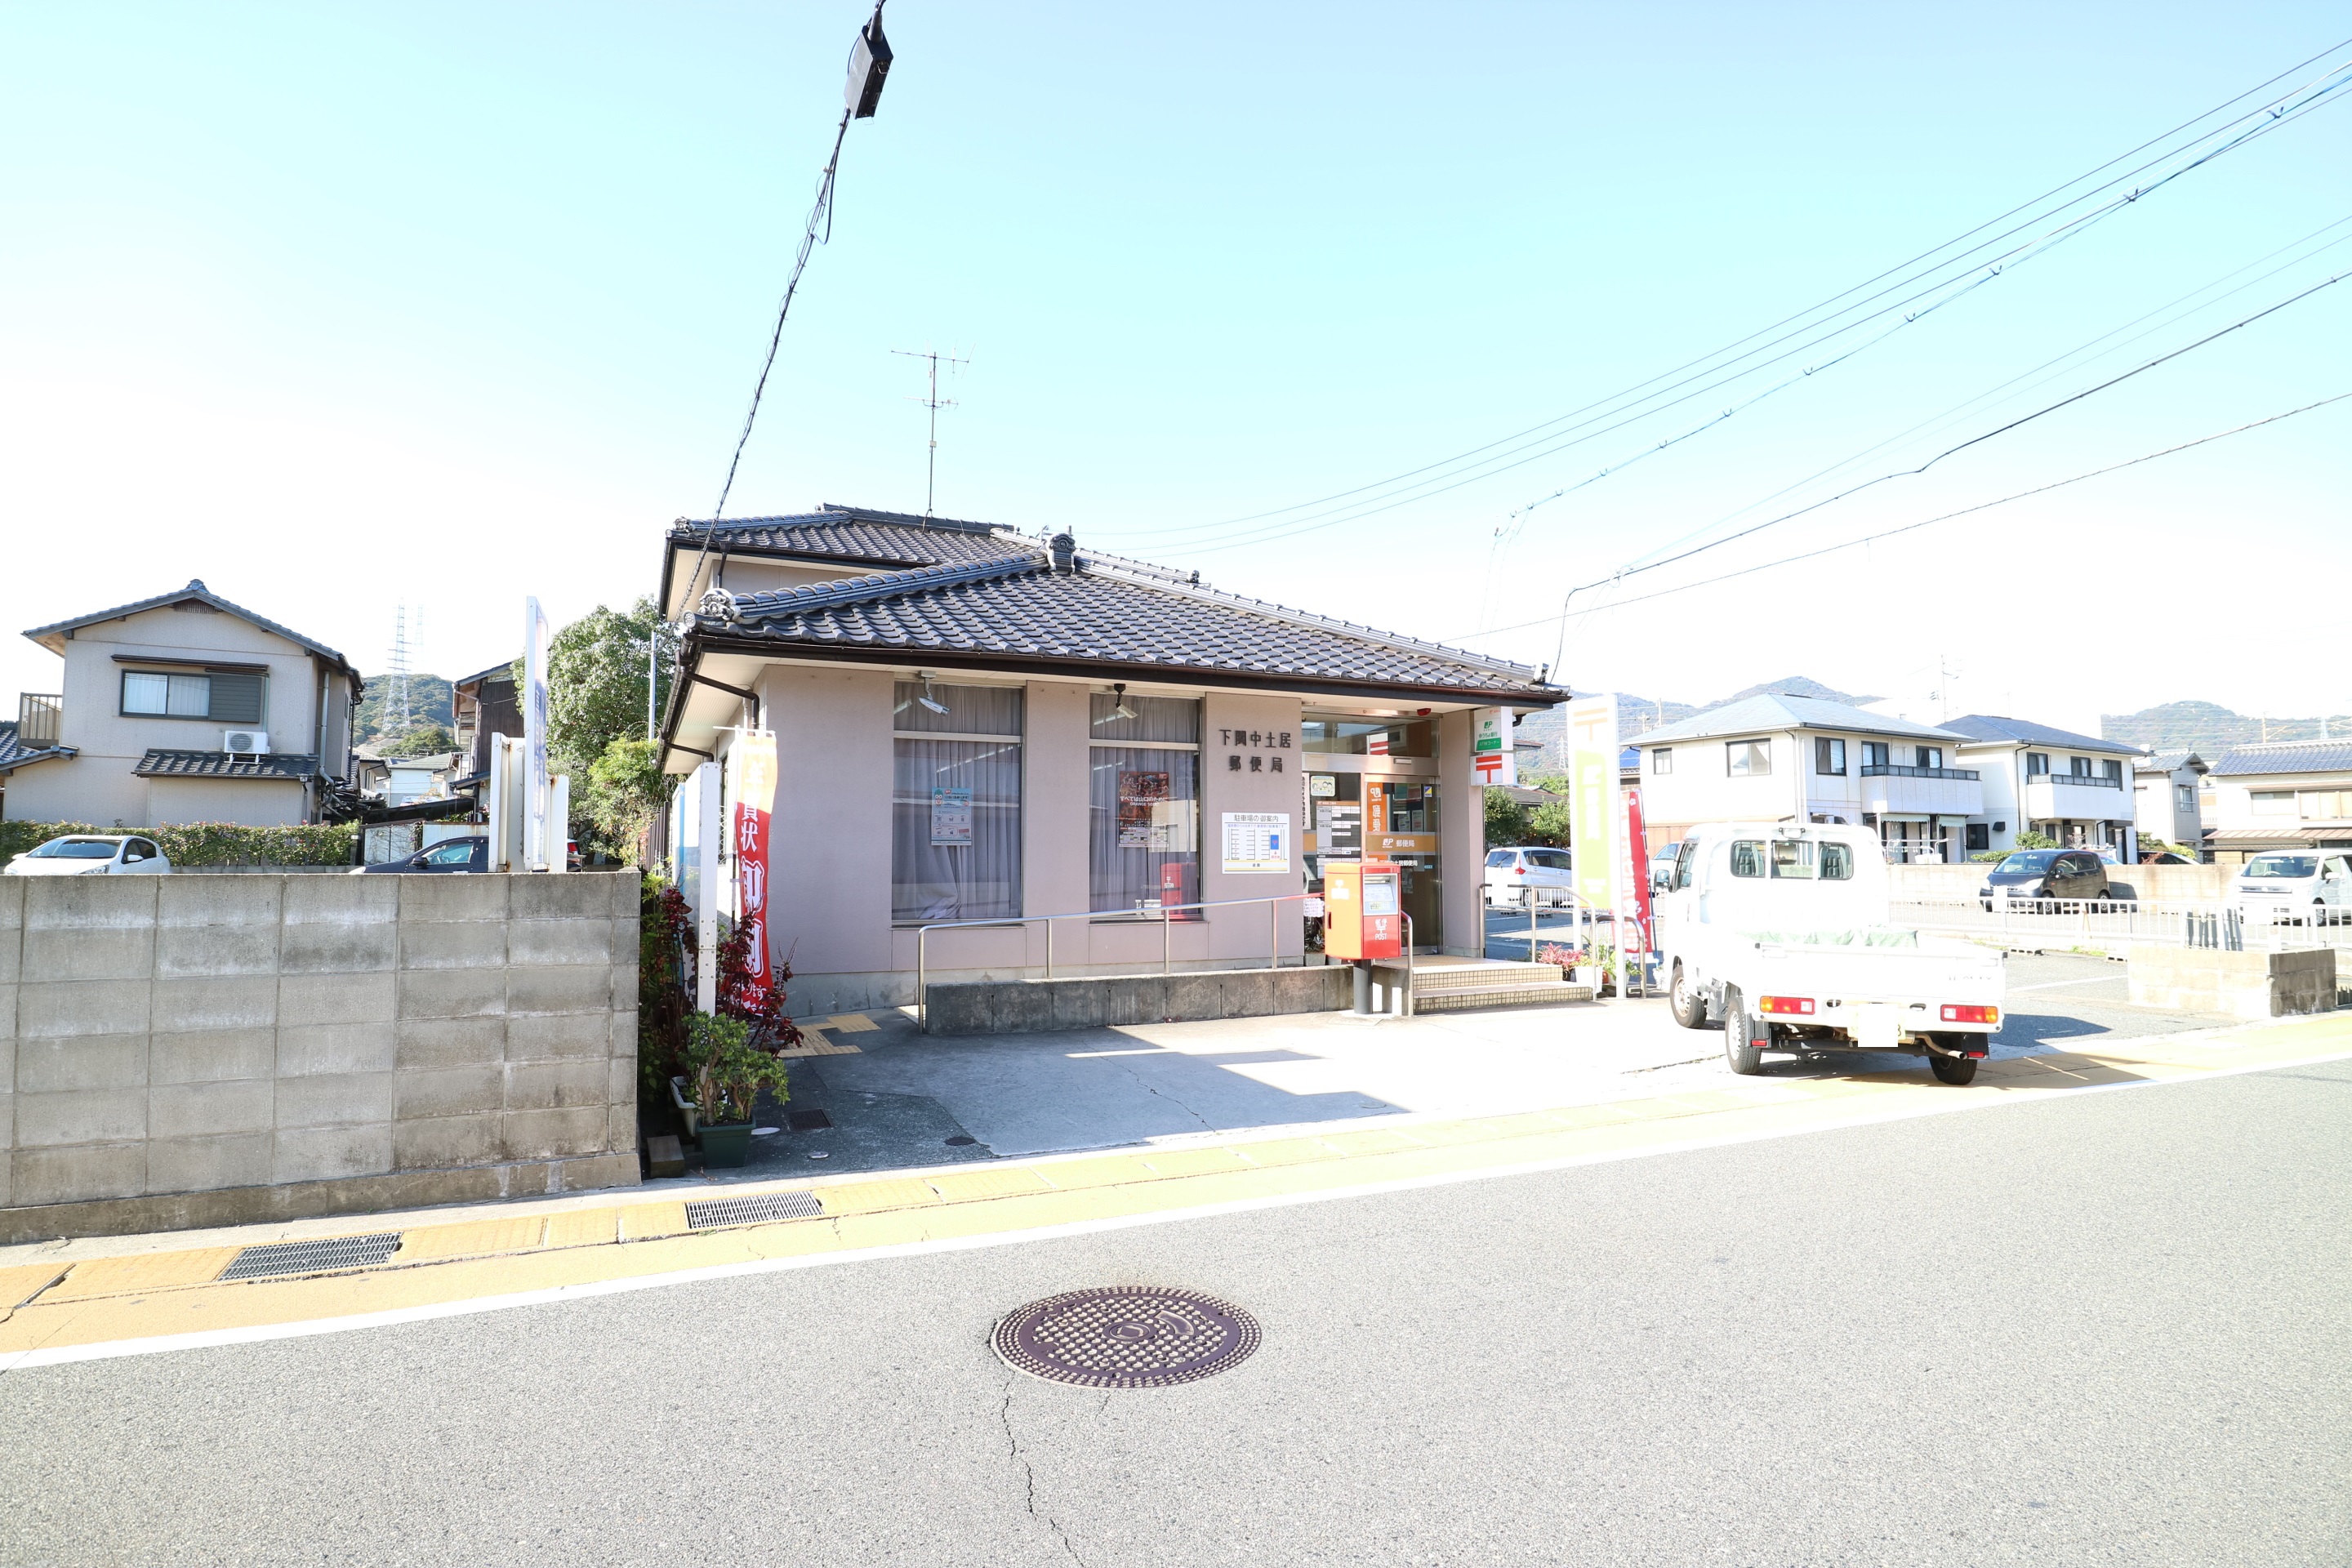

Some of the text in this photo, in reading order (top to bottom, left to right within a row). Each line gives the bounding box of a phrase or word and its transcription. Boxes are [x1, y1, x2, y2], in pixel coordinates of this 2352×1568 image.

[1218, 729, 1291, 748] 下関中土居
[1229, 755, 1282, 773] 郵便局
[1234, 814, 1279, 822] 駐車場の御案内
[1396, 840, 1415, 848] 郵便局
[1374, 933, 1388, 941] POST
